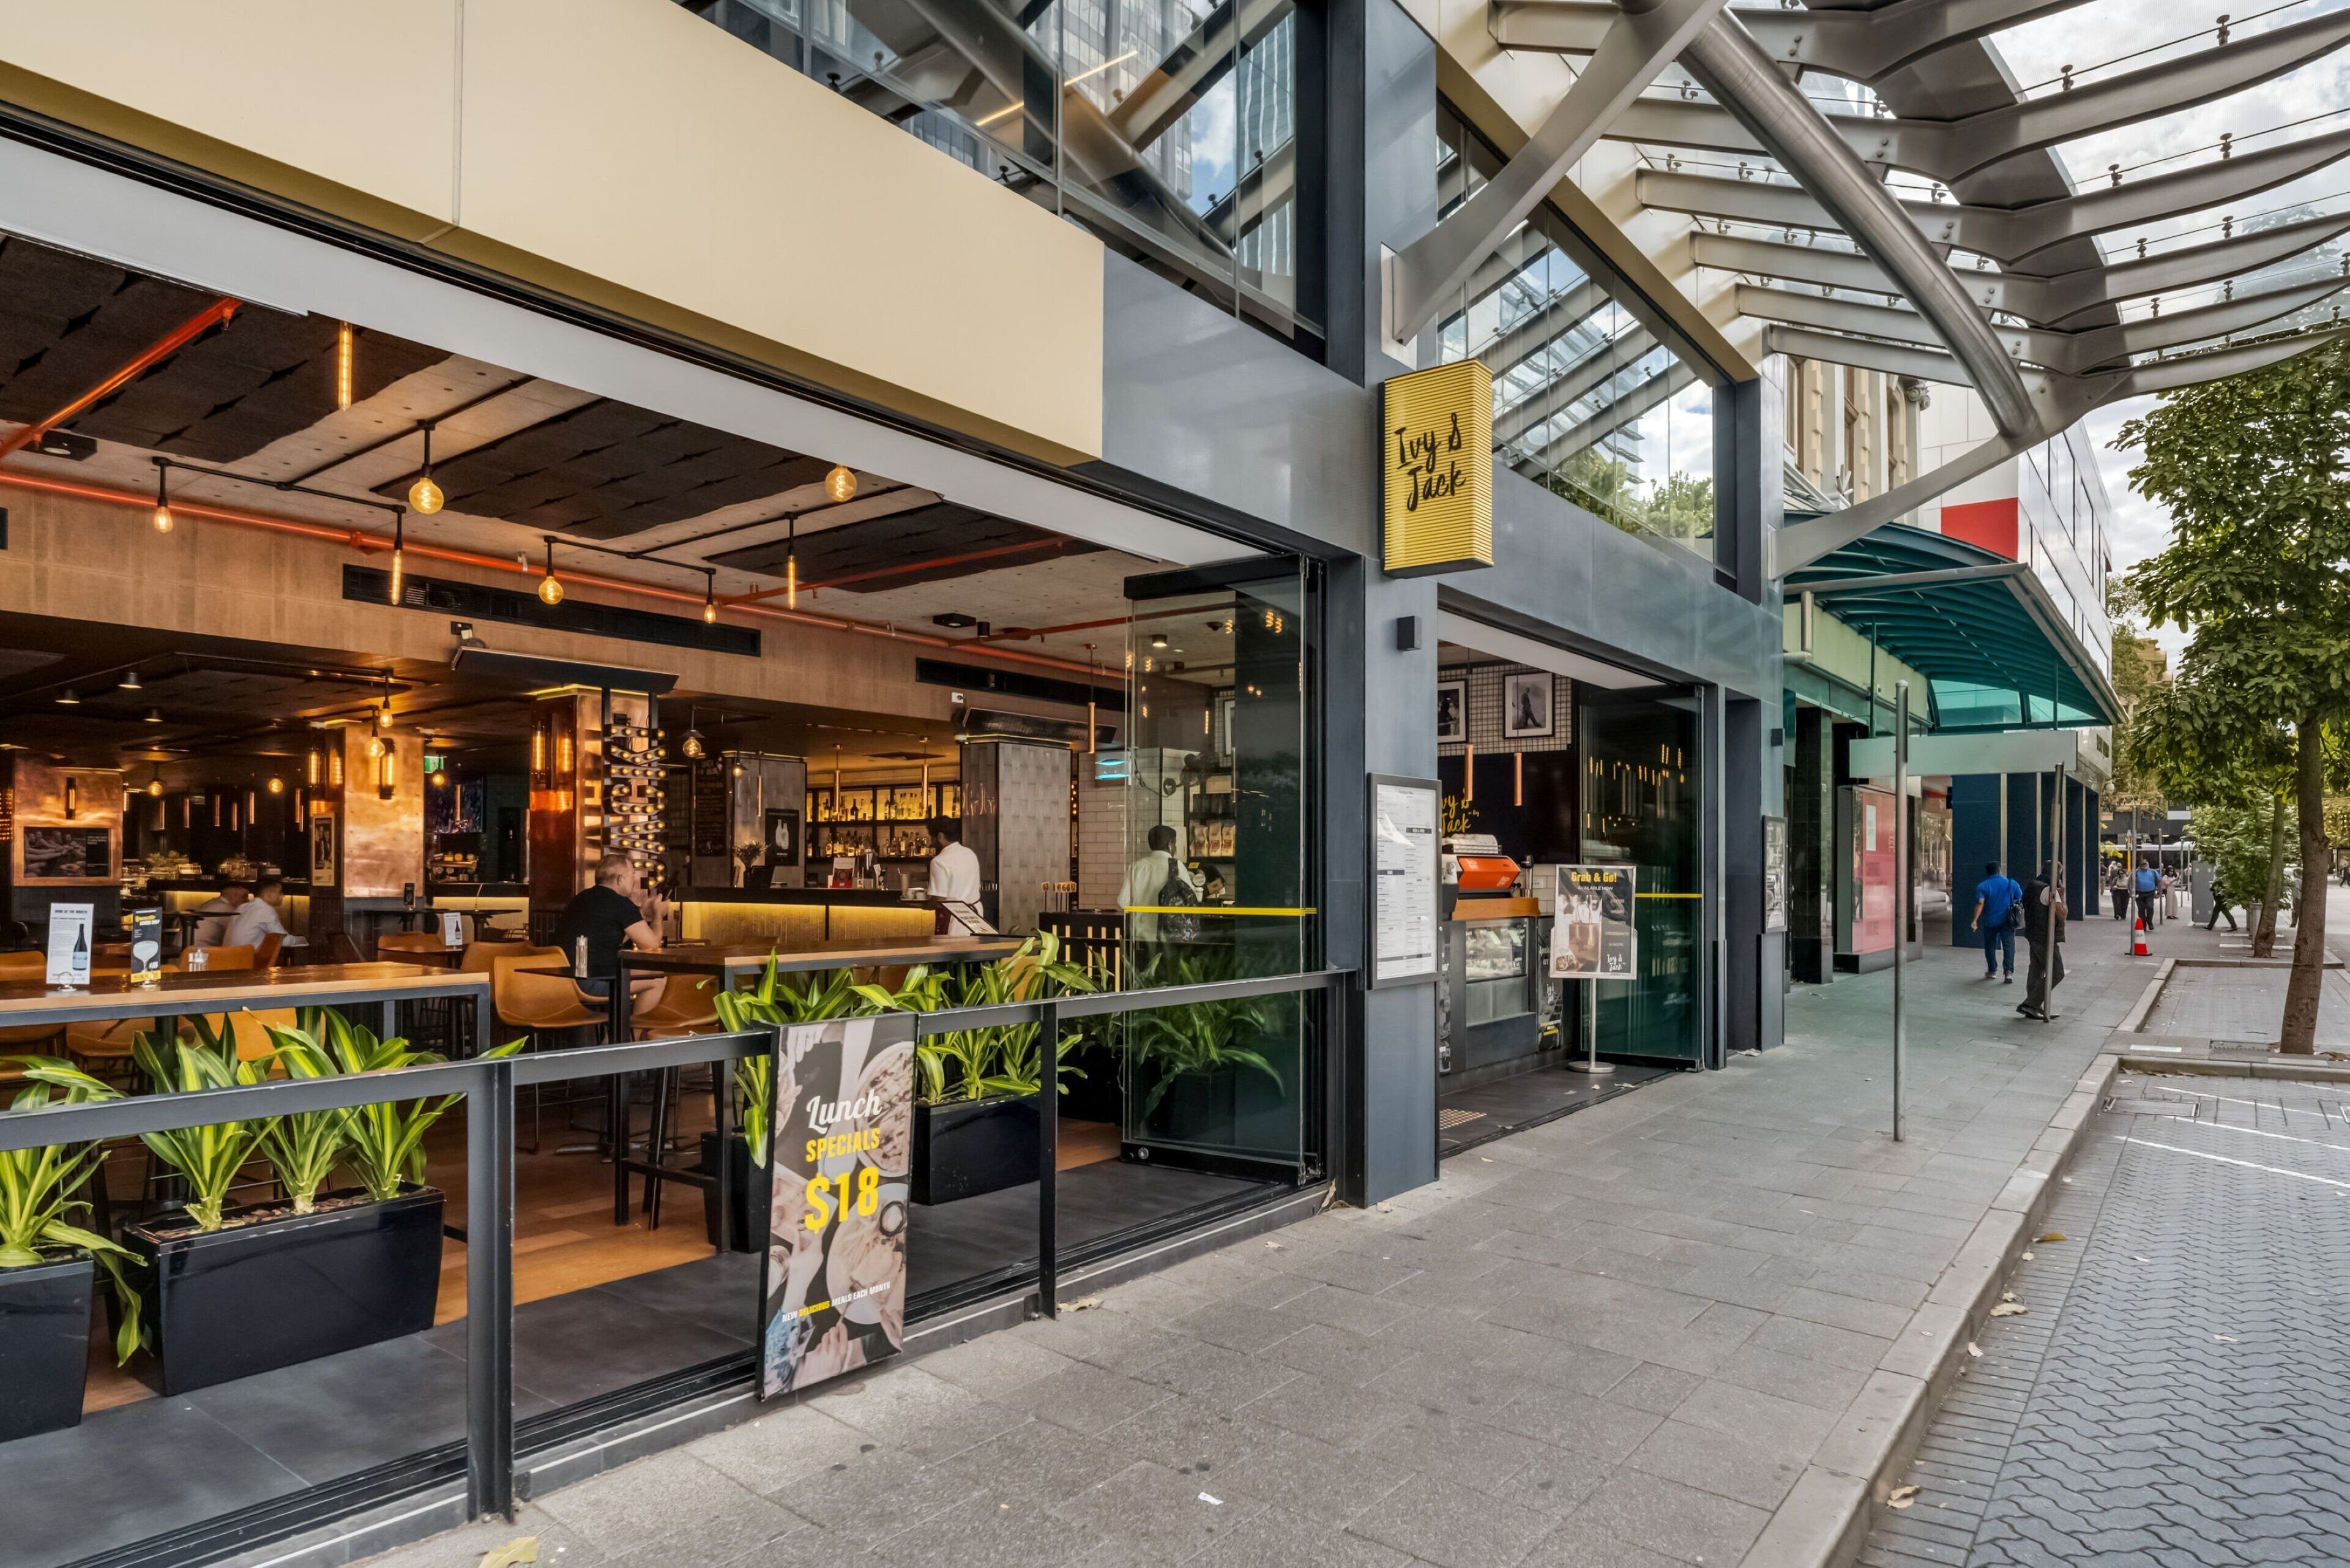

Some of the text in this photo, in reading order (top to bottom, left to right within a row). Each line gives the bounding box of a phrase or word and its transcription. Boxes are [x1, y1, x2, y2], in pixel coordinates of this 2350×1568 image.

[1394, 412, 1462, 474] Ivy &
[1406, 460, 1467, 512] Jack
[1441, 795, 1459, 819] vy
[1441, 813, 1472, 837] Jack
[1571, 872, 1617, 883] Grab & Go!
[1606, 954, 1617, 965] Ivy
[1609, 963, 1623, 972] Jack
[806, 1088, 882, 1135] Lunch
[805, 1127, 881, 1162] SPECIALS
[805, 1165, 880, 1235] $18
[782, 1281, 891, 1323] NEW DELICIOUS MEALS EACH MONTH
